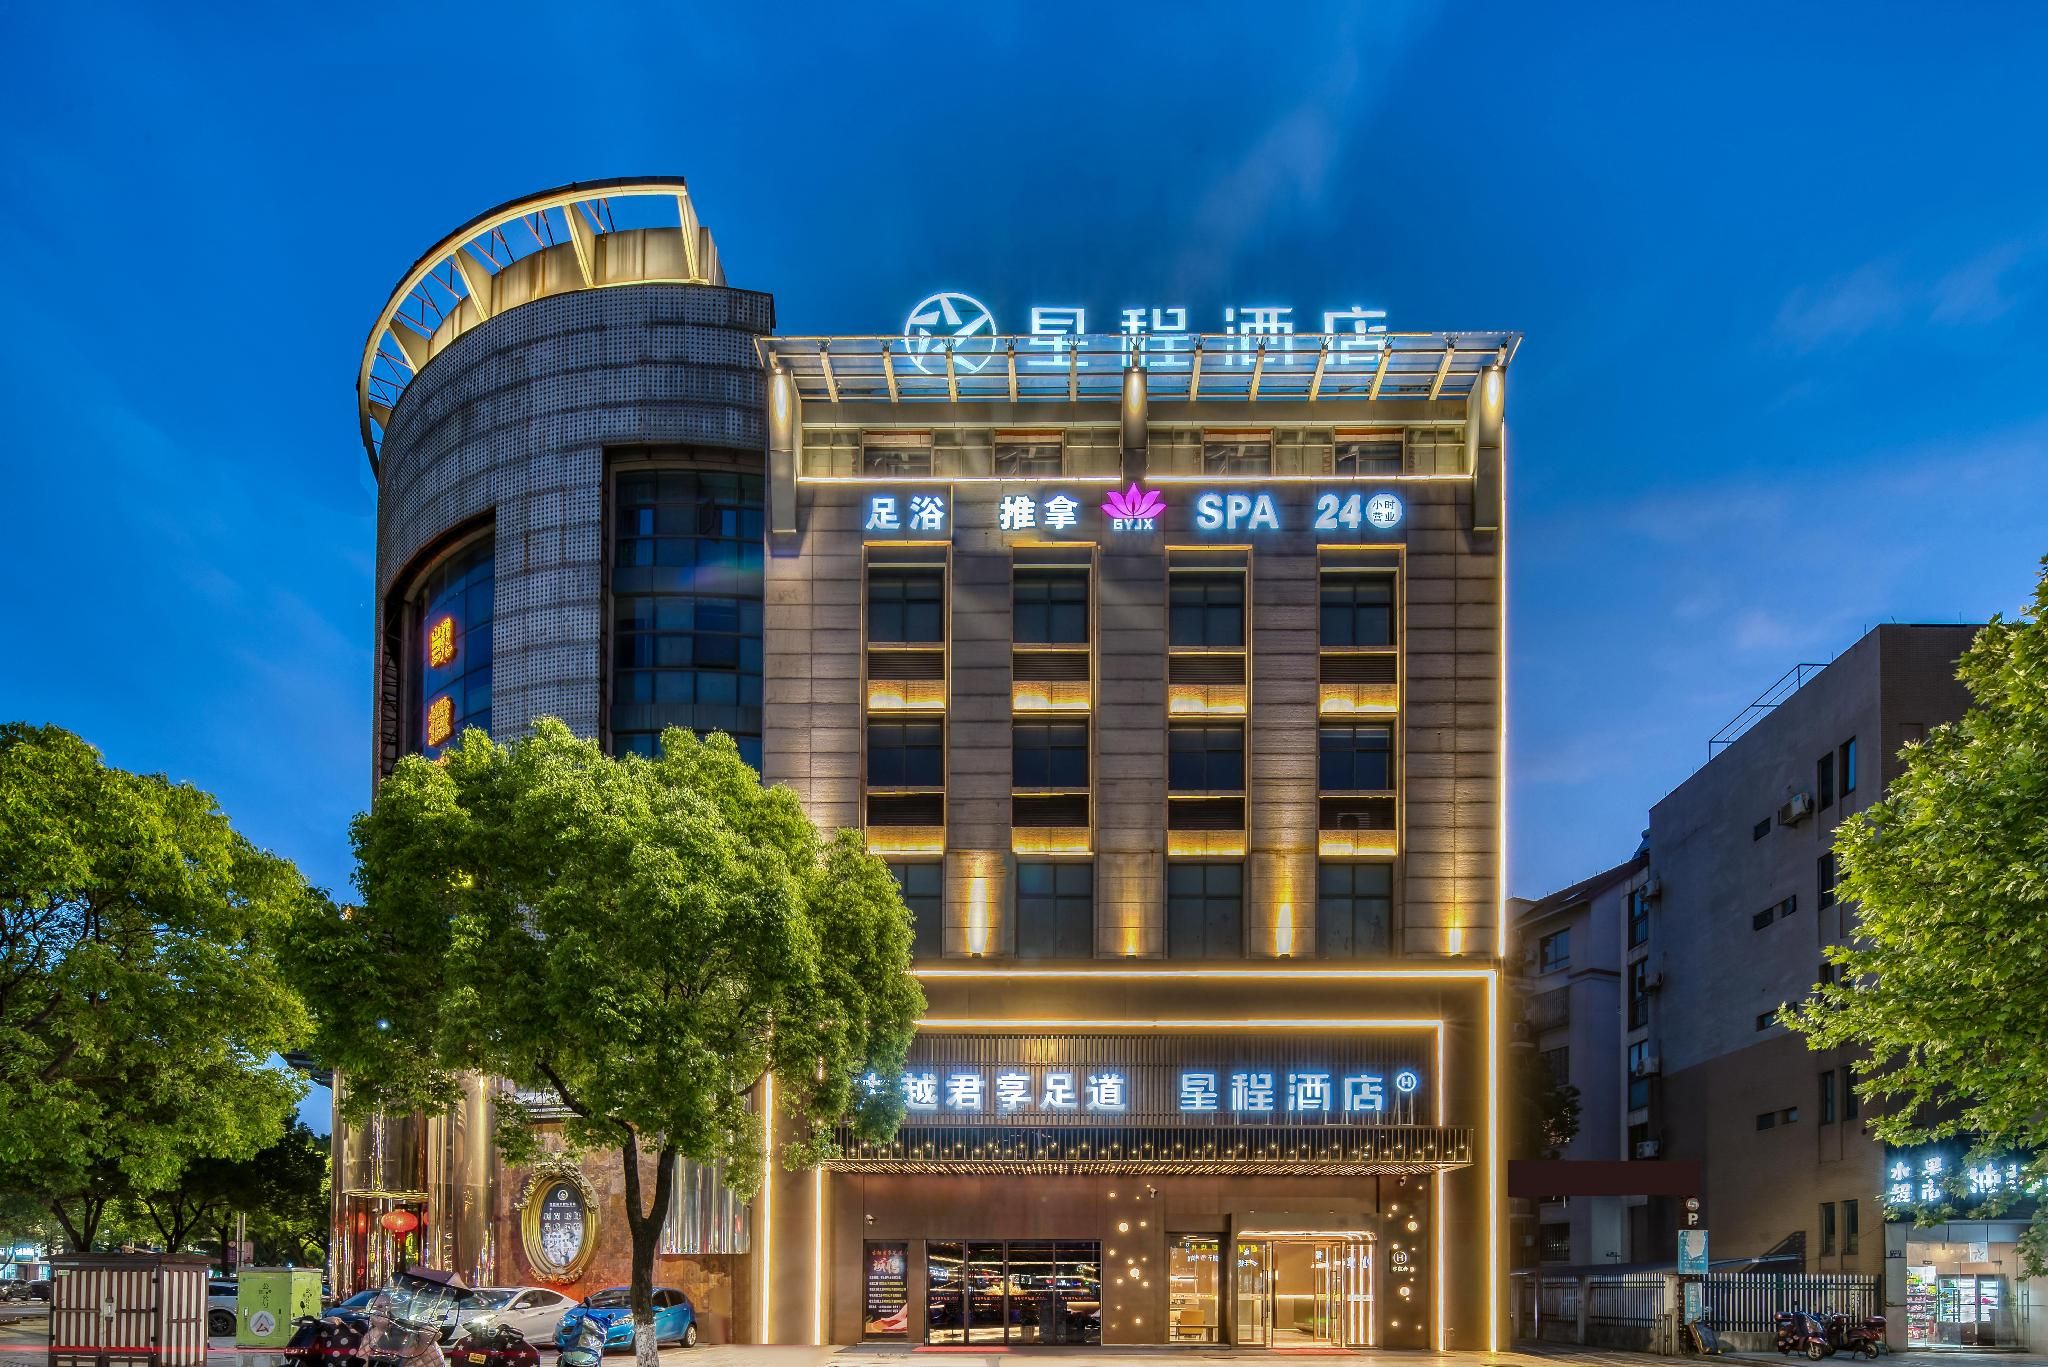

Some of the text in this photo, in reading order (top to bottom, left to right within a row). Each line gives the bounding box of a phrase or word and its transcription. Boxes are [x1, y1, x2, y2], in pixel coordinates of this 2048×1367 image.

[1026, 306, 1387, 367] 星程酒店
[866, 495, 1079, 530] 足浴 推拿
[1196, 493, 1362, 529] SPA 24
[1372, 499, 1396, 510] 小时
[1372, 511, 1396, 522] 营业
[1112, 518, 1154, 530] GYJX
[1180, 1073, 1383, 1111] 星程酒店
